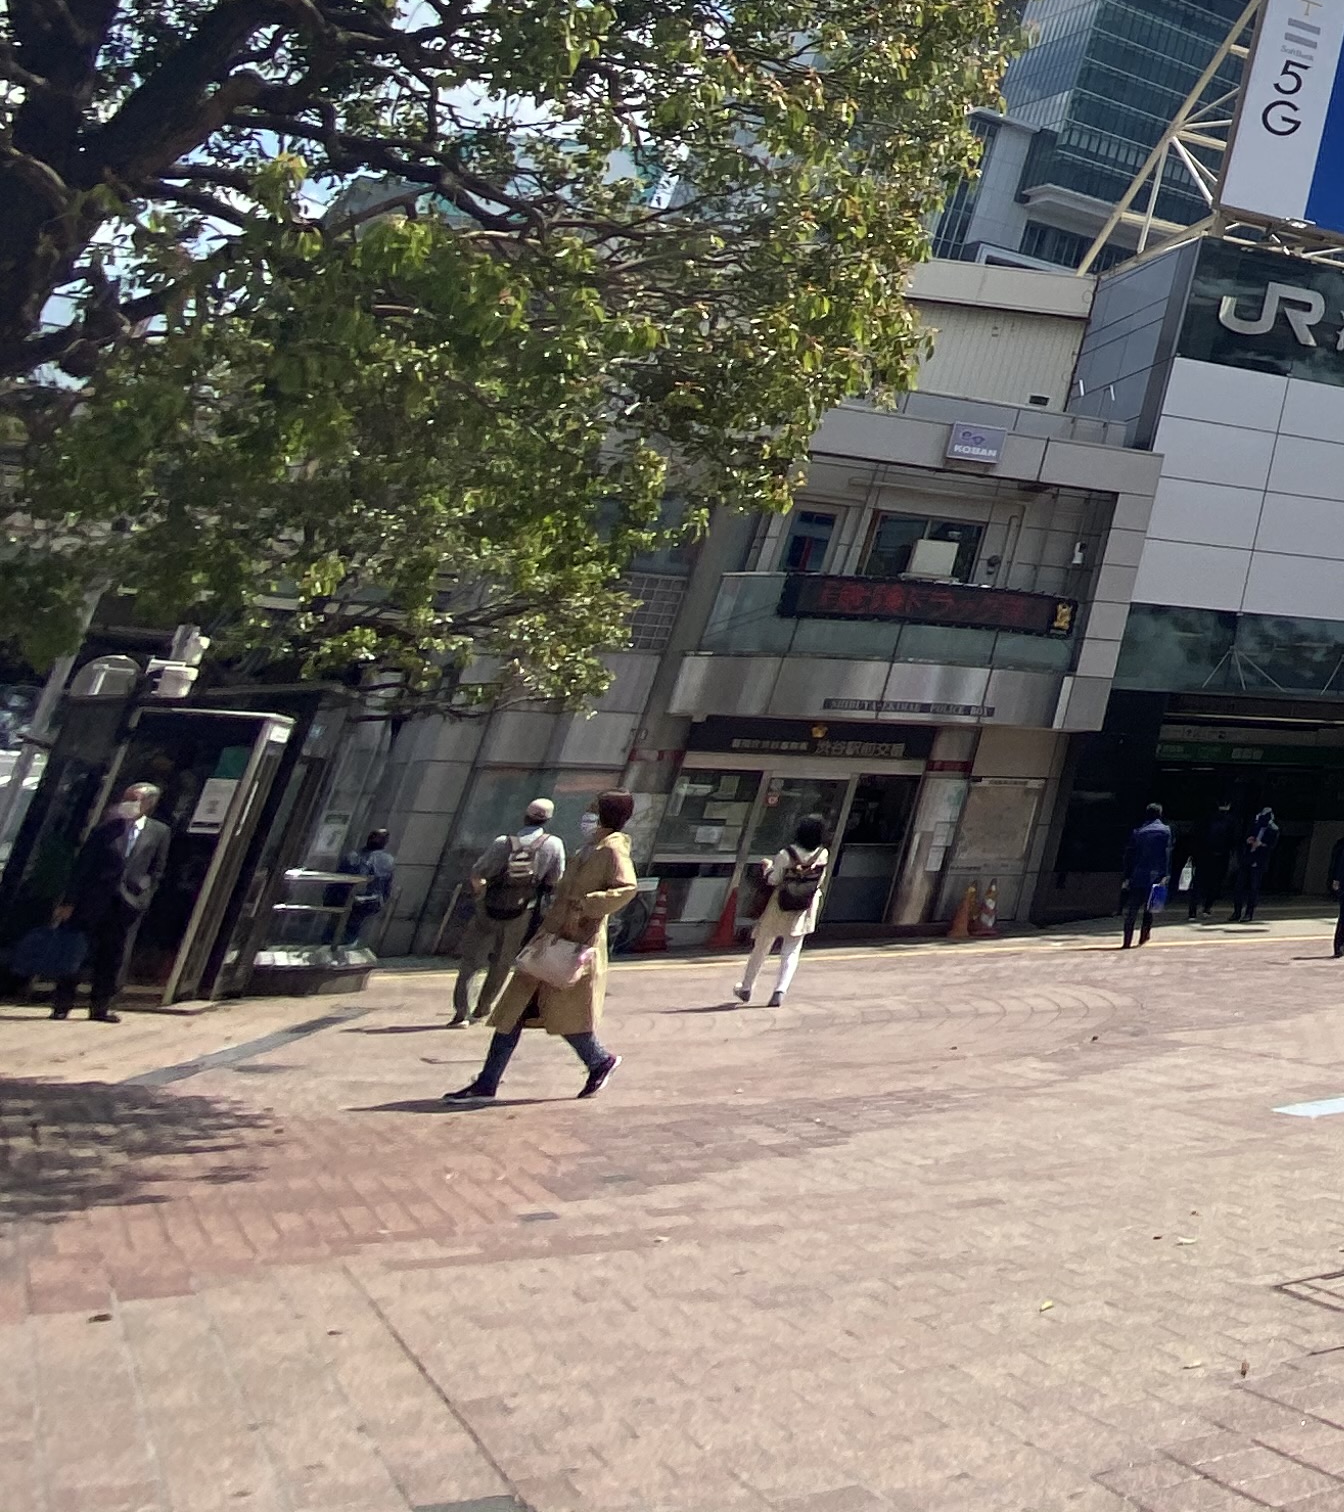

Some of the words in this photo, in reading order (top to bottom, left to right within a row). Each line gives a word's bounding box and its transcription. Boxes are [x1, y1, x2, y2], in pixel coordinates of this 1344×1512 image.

[1261, 59, 1312, 137] 5G
[1219, 281, 1325, 348] JR
[953, 444, 998, 457] KOBAN
